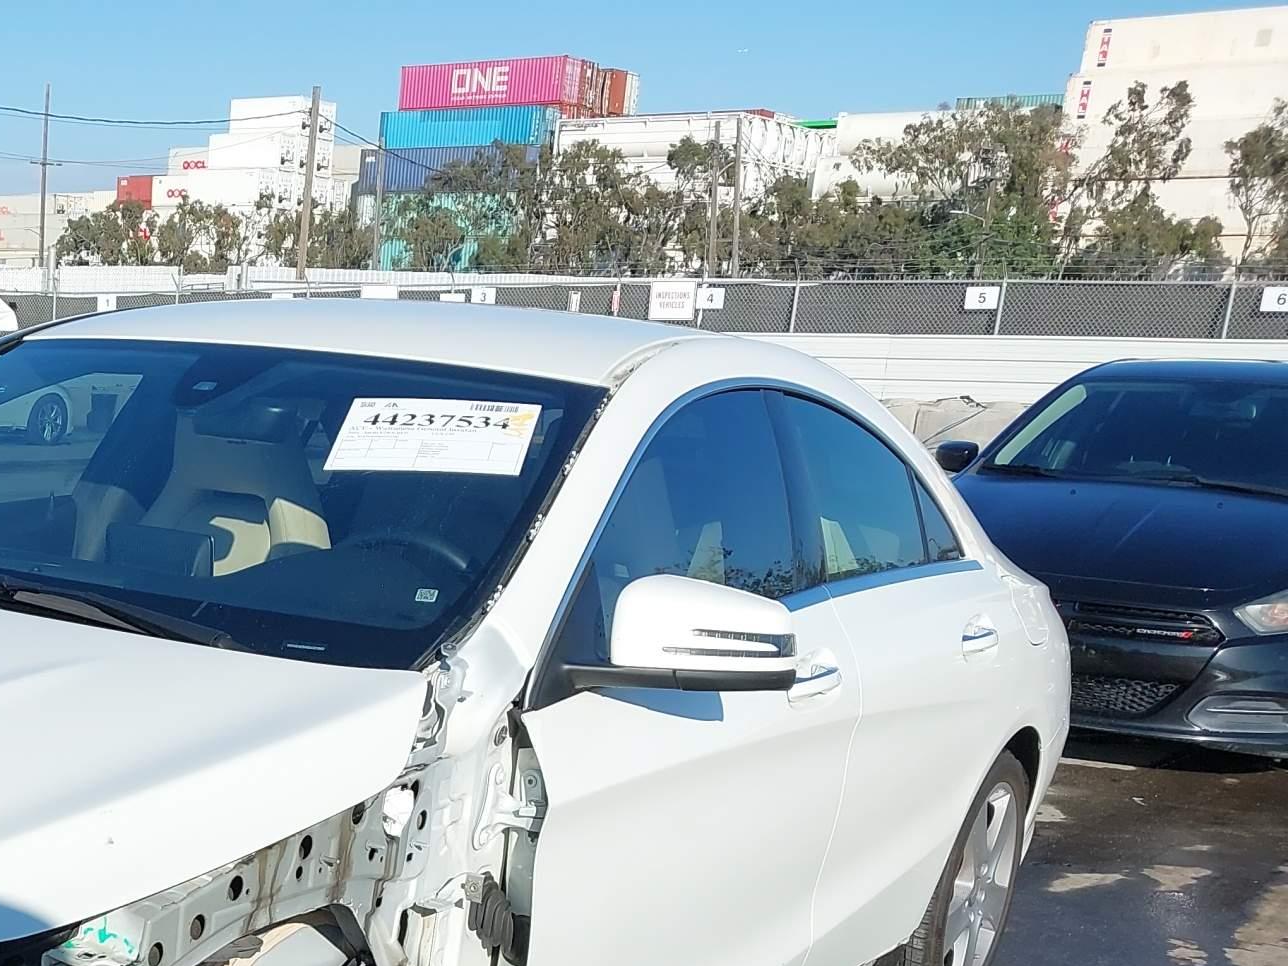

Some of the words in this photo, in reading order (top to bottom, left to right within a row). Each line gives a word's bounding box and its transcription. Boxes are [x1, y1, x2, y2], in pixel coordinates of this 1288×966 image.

[451, 66, 510, 95] ONE
[182, 160, 207, 171] OOCL
[480, 292, 487, 302] 3
[707, 293, 714, 304] 4
[977, 292, 987, 304] 5
[1277, 293, 1288, 305] 6
[363, 412, 511, 430] 44237534
